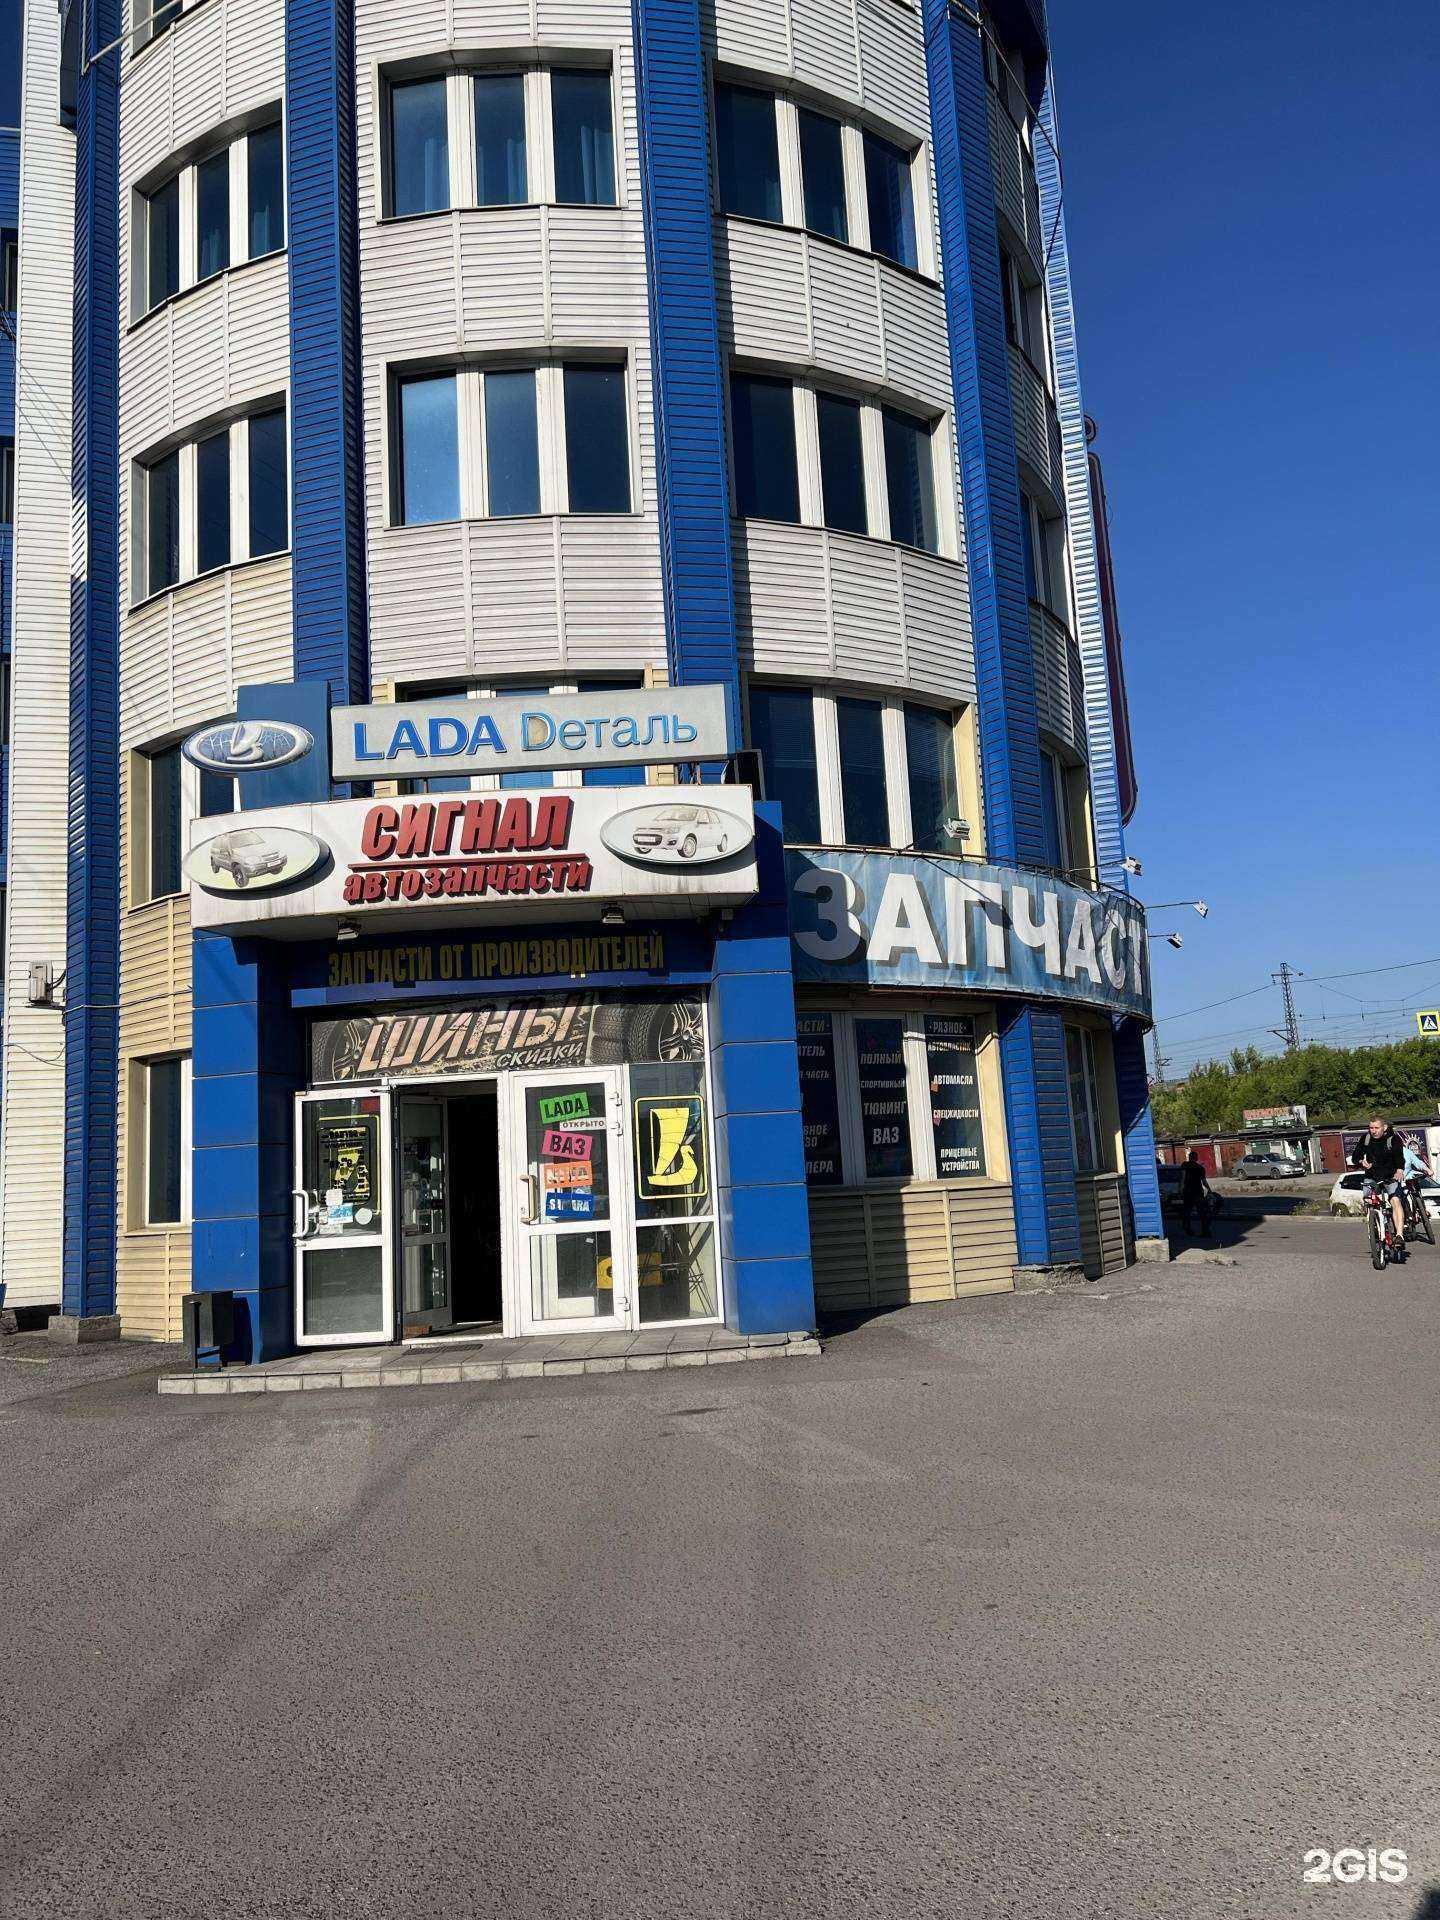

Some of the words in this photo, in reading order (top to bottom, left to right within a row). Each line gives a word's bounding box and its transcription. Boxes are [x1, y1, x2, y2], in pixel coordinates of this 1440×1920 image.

[353, 714, 509, 761] LADA
[360, 795, 576, 861] СИГНАЛ
[793, 868, 1149, 996] ЗАПЧАСТ
[328, 945, 432, 987] ЗАПЧАСТИ
[440, 943, 465, 979] ОТ
[472, 931, 664, 977] ПРОИЗВОДИТЕЛЕЙ
[357, 993, 586, 1073] ШИНЫ
[932, 1021, 964, 1034] РАЗНОЕ
[860, 1050, 901, 1064] ПОЛНЫЙ
[933, 1075, 974, 1085] АВТОМАСЛА
[544, 1097, 585, 1119] LADA
[864, 1101, 907, 1115] ТЮНИНГ
[933, 1109, 979, 1119] СПЕЦЖИДКОСТИ
[562, 1120, 605, 1129] ОТКРЫТО
[872, 1126, 900, 1145] ВАЗ
[549, 1134, 586, 1156] ВАЗ
[941, 1147, 978, 1159] ПРИЦЕПНЫЕ
[942, 1159, 980, 1171] УСТРОЙСТВА
